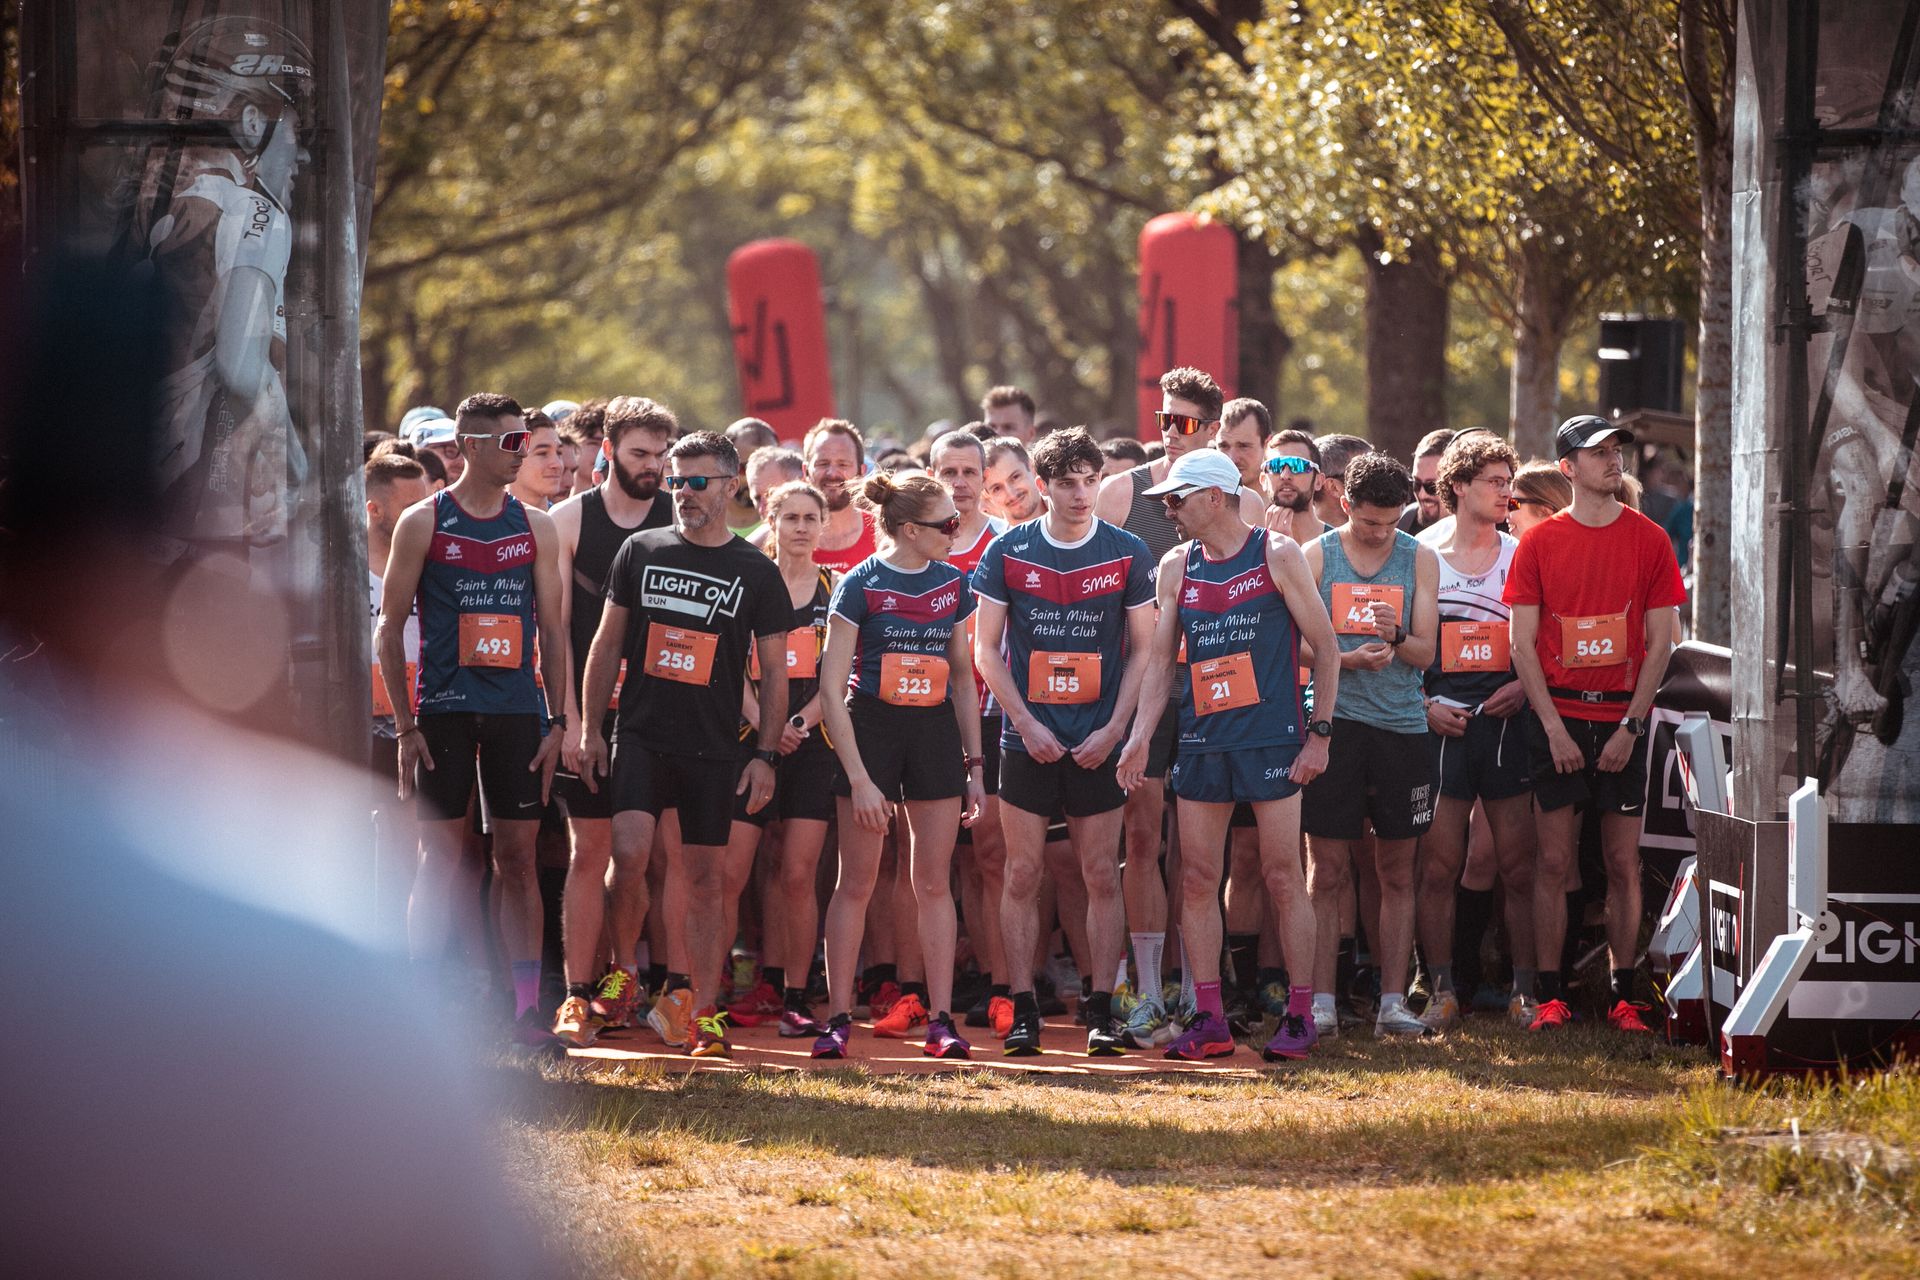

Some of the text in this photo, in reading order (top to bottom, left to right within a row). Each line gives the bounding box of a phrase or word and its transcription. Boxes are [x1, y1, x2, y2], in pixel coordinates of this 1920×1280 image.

[496, 541, 531, 562] SMAC
[454, 579, 488, 592] Saint
[649, 574, 702, 597] LIGHT
[1082, 572, 1121, 594] SMAC
[1228, 574, 1264, 600] SMAC
[460, 594, 522, 606] Athlé Club
[648, 597, 667, 606] RUN
[930, 592, 958, 613] SMAC
[1029, 608, 1104, 623] Saint Mihiel
[1191, 612, 1261, 634] Saint Mihiel
[1347, 606, 1375, 623] 42
[883, 625, 953, 639] Saint Mihie
[1032, 624, 1097, 638] Athlé Club
[1197, 629, 1256, 648] Athlé Club
[475, 638, 511, 656] 493
[1460, 644, 1492, 661] 418
[1577, 638, 1614, 656] 562
[657, 649, 696, 672] 258
[1201, 669, 1238, 682] JEAN-MICHEL
[897, 676, 931, 695] 323
[1047, 676, 1080, 693] 155
[1210, 680, 1231, 700] 21
[1264, 767, 1291, 780] SMA
[1412, 809, 1431, 826] NIKE
